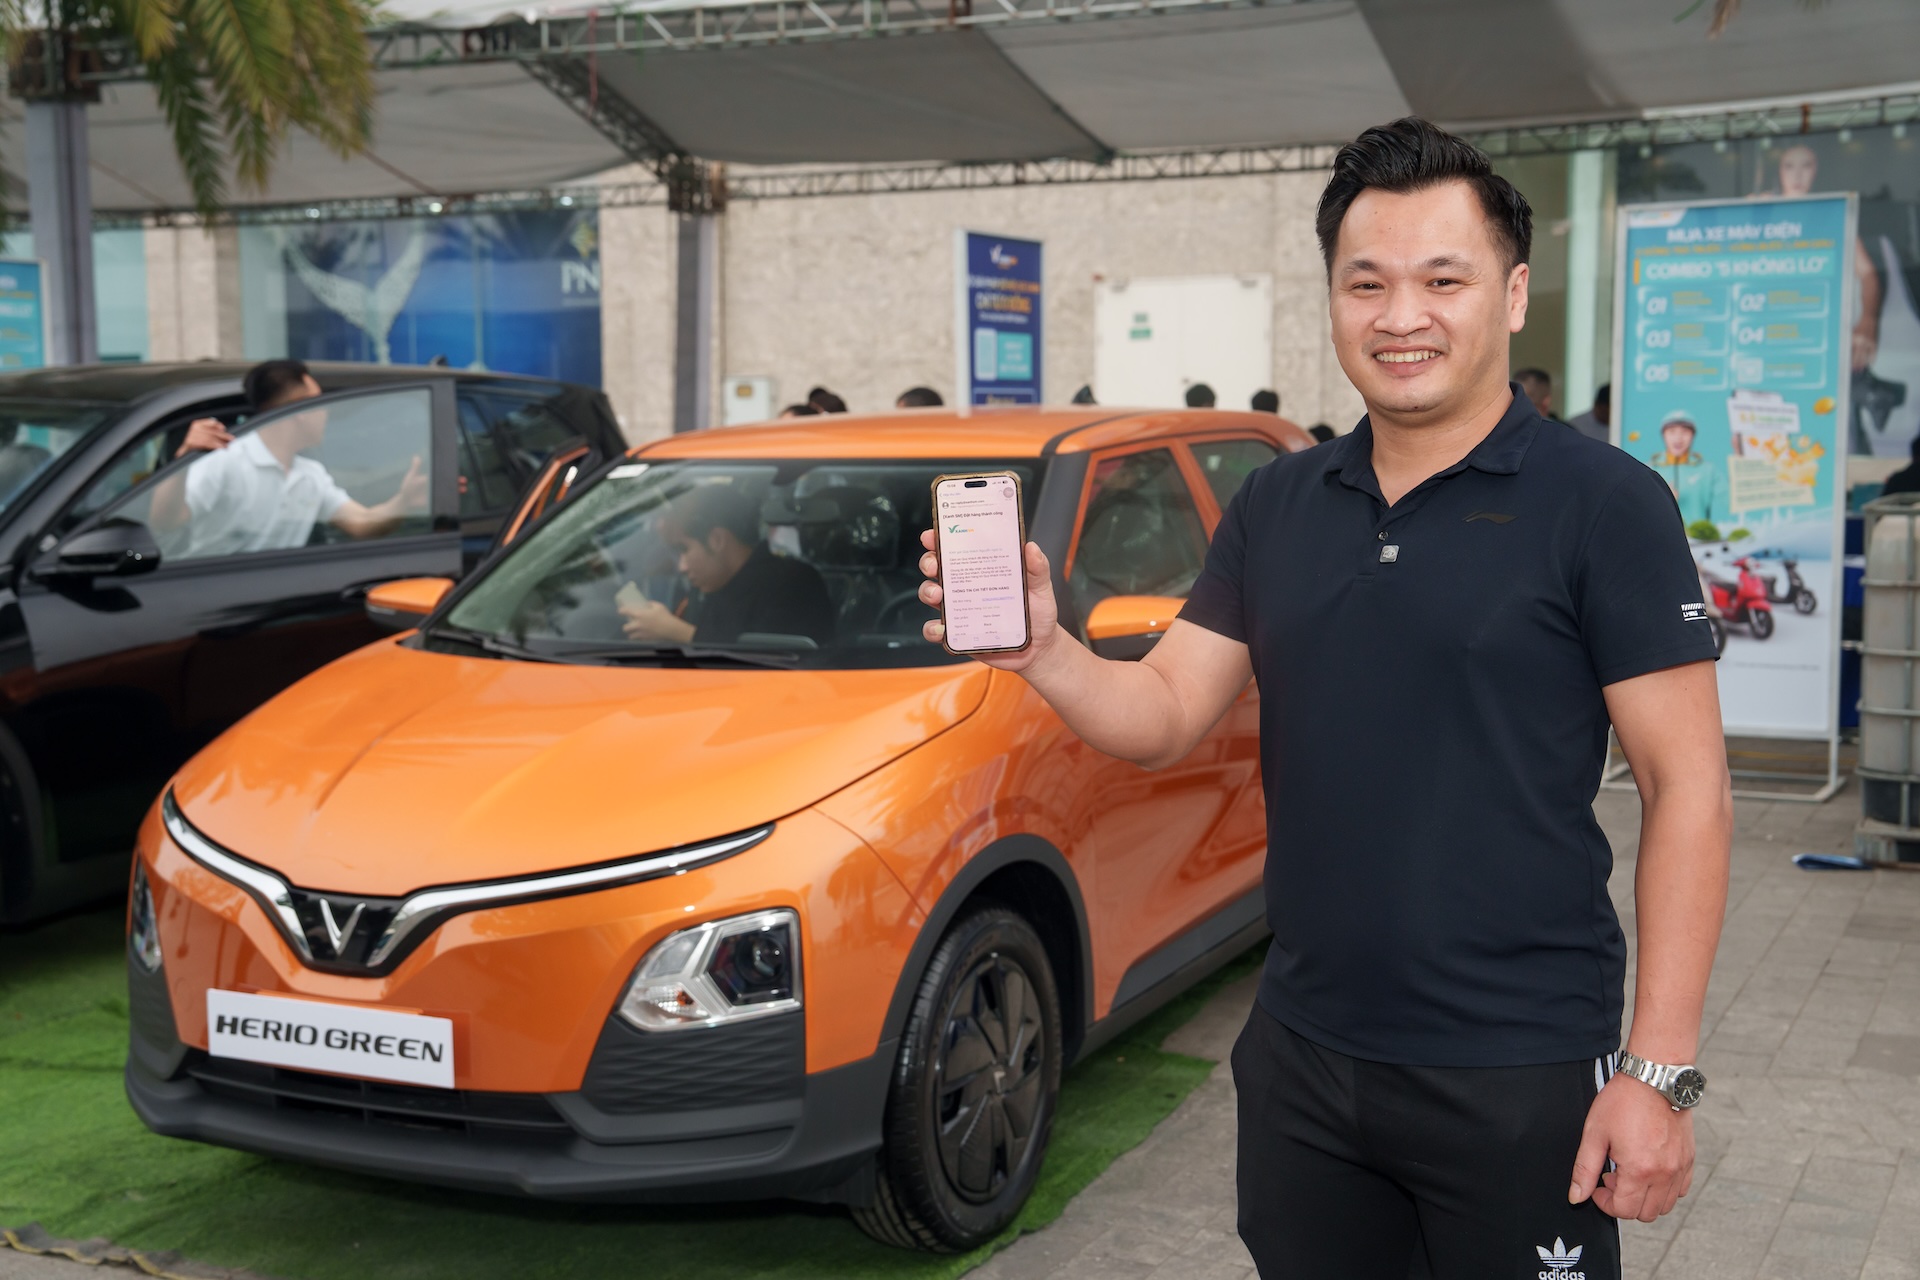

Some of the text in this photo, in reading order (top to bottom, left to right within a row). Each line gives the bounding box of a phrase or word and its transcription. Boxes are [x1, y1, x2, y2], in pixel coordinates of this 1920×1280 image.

[1667, 228, 1703, 243] MUA
[1705, 227, 1726, 241] XE
[1646, 261, 1712, 280] COMBO
[1647, 297, 1668, 315] 01
[1740, 293, 1766, 312] 02
[1646, 329, 1671, 348] 03
[1738, 326, 1764, 345] 04
[215, 1015, 443, 1063] HERIO GREEN
[1538, 1268, 1586, 1280] adidas
